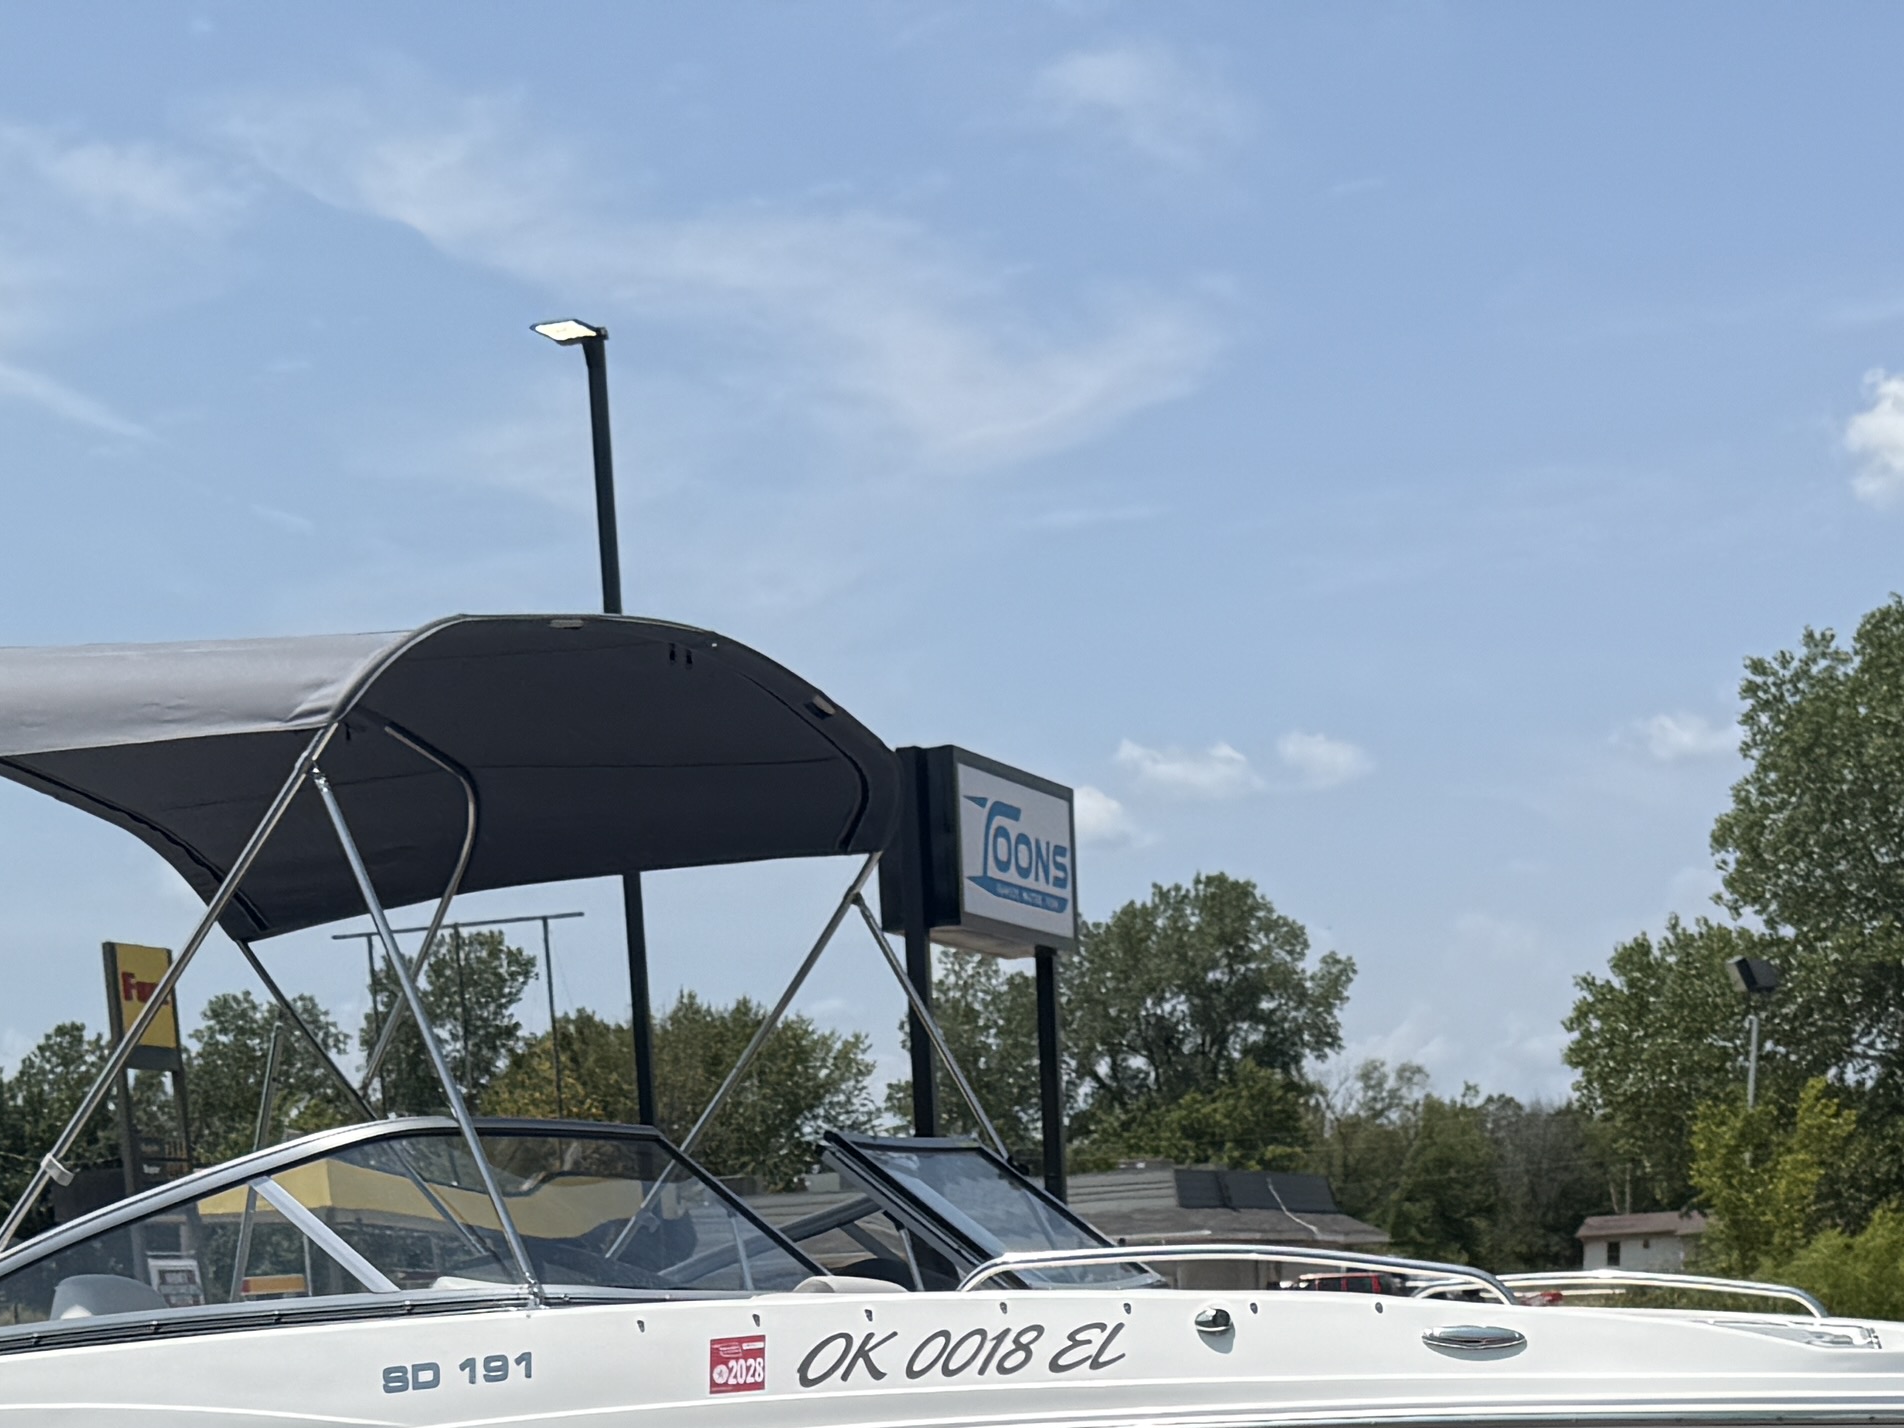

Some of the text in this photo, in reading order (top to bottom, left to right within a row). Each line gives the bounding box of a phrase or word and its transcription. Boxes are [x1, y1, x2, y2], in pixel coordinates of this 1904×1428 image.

[962, 795, 1069, 890] TOONS
[382, 1351, 533, 1394] SD 191
[727, 1357, 764, 1385] 2028
[797, 1322, 1126, 1389] OK 0018 EL
